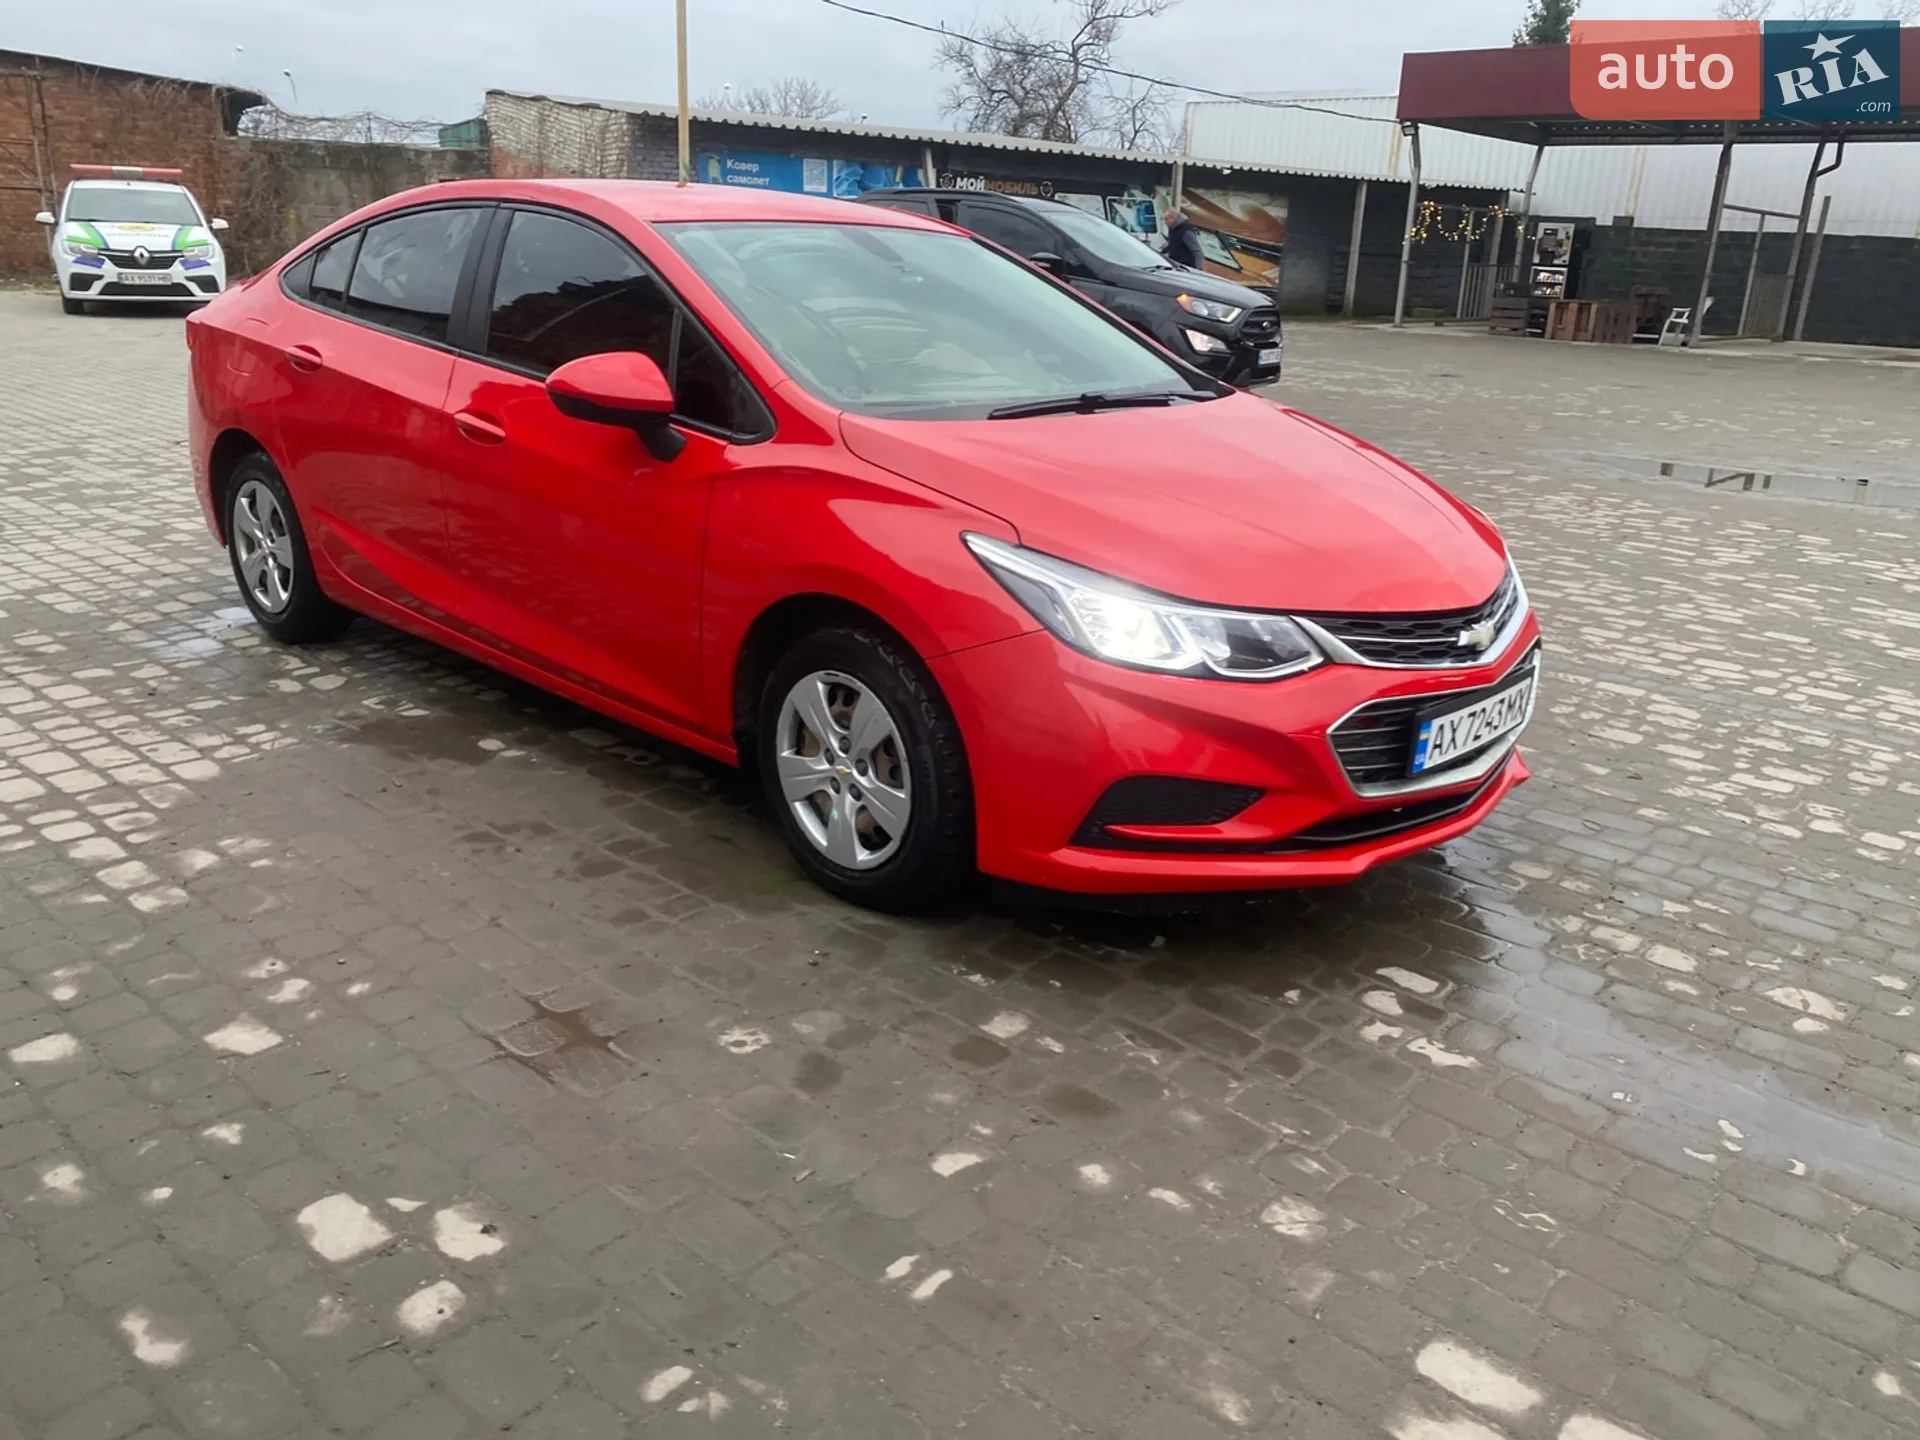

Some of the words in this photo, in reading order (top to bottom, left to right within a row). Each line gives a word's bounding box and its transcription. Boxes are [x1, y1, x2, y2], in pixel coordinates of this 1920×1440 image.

[726, 158, 759, 173] Ковер
[726, 174, 770, 186] самолет
[1429, 715, 1464, 761] AX
[1462, 697, 1506, 748] 7243
[1503, 684, 1530, 727] MX
